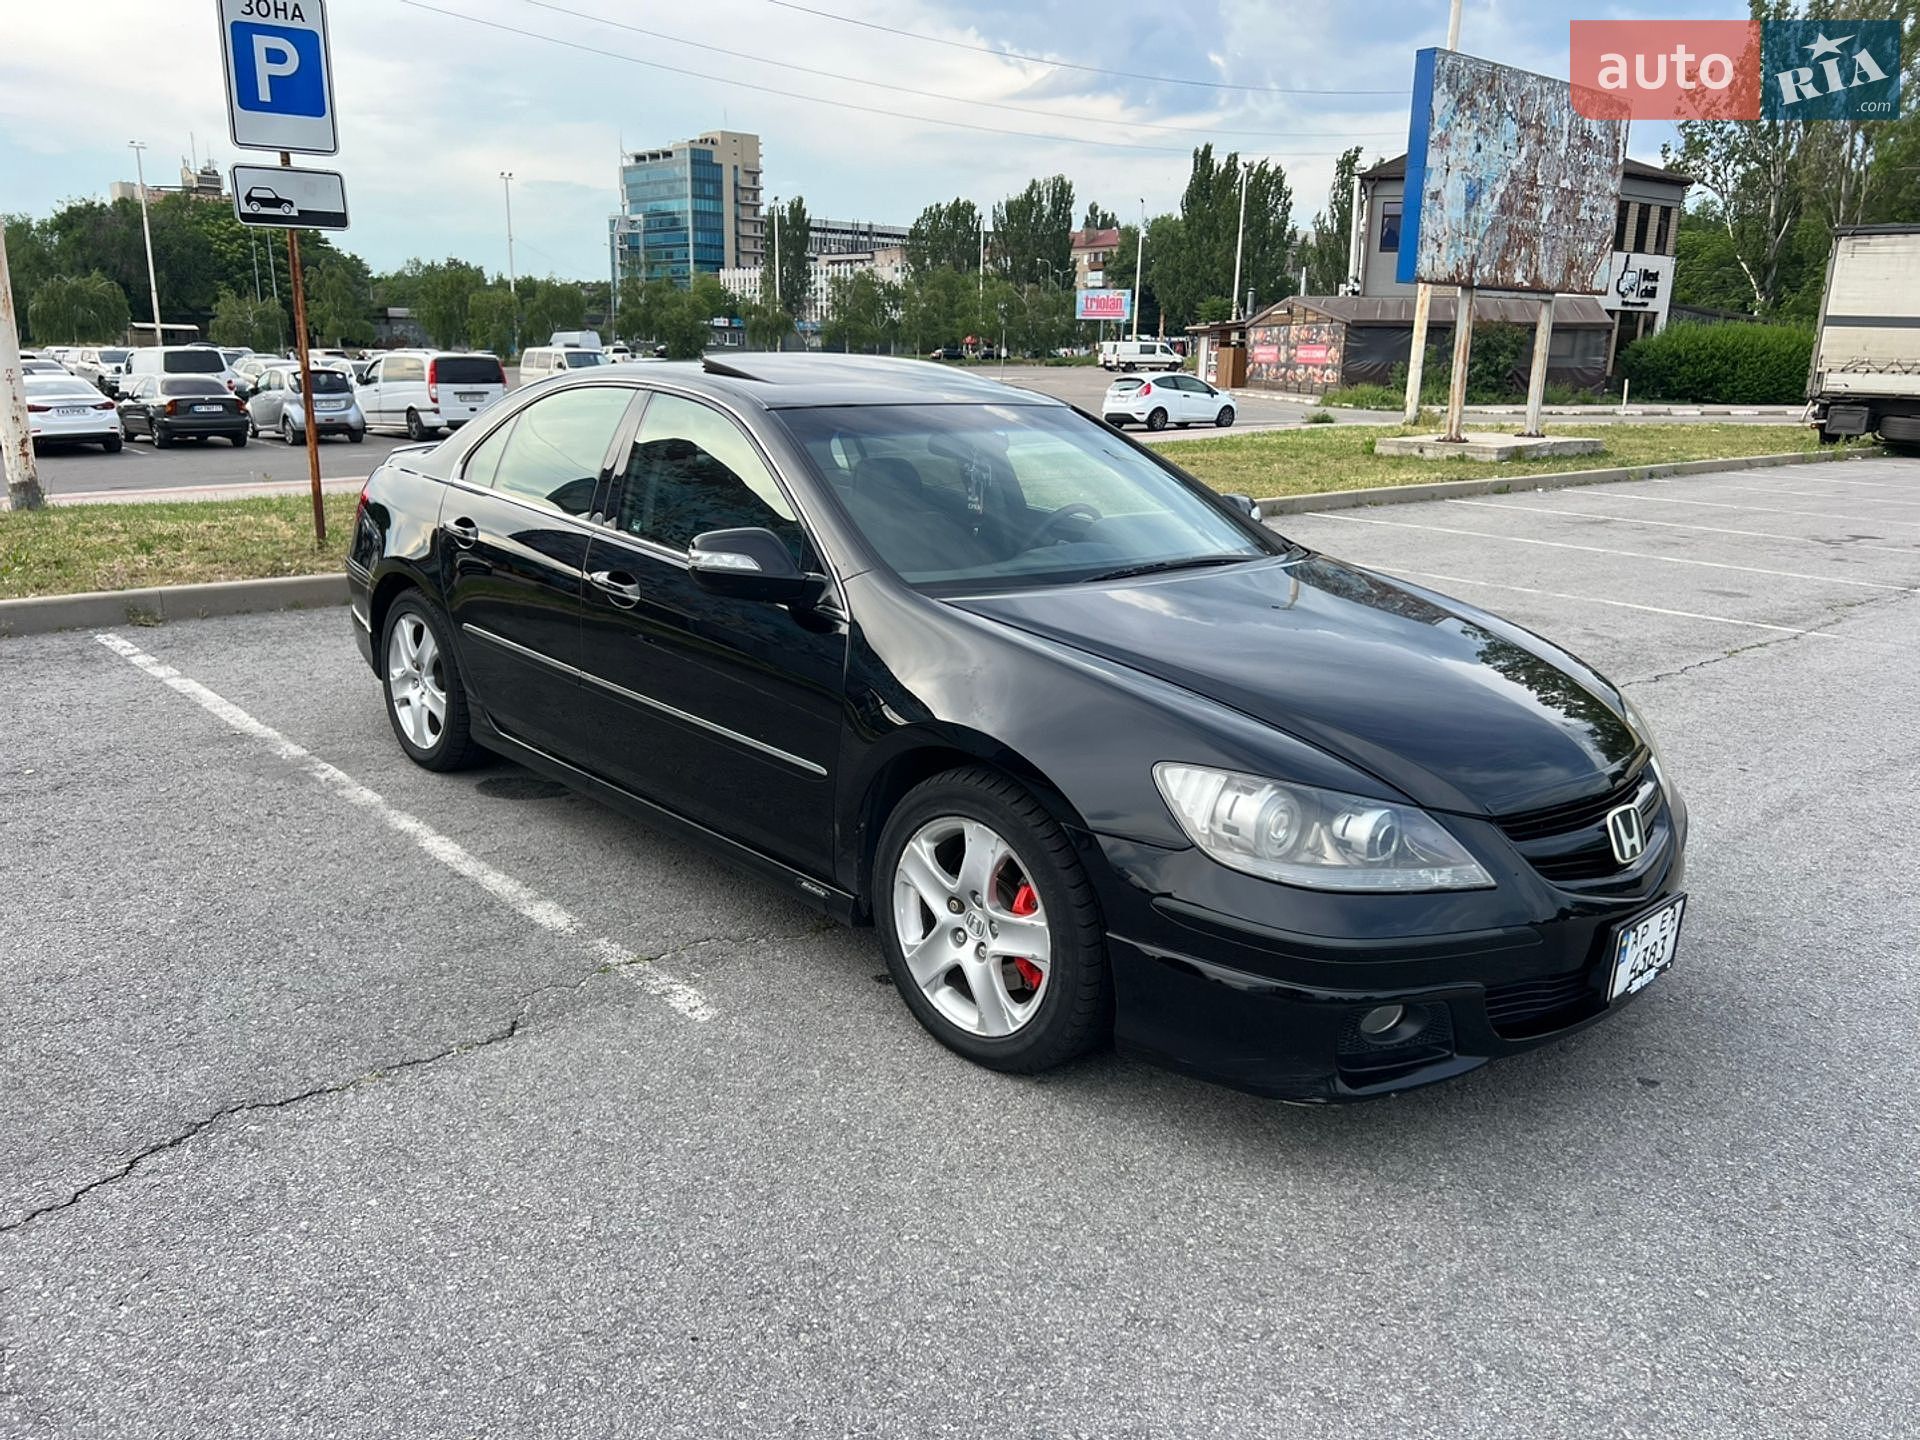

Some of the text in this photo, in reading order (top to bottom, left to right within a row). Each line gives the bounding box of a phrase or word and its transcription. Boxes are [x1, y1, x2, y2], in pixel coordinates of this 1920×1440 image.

[241, 0, 305, 22] ЗОНА
[252, 34, 299, 102] P
[1085, 295, 1123, 310] triolan
